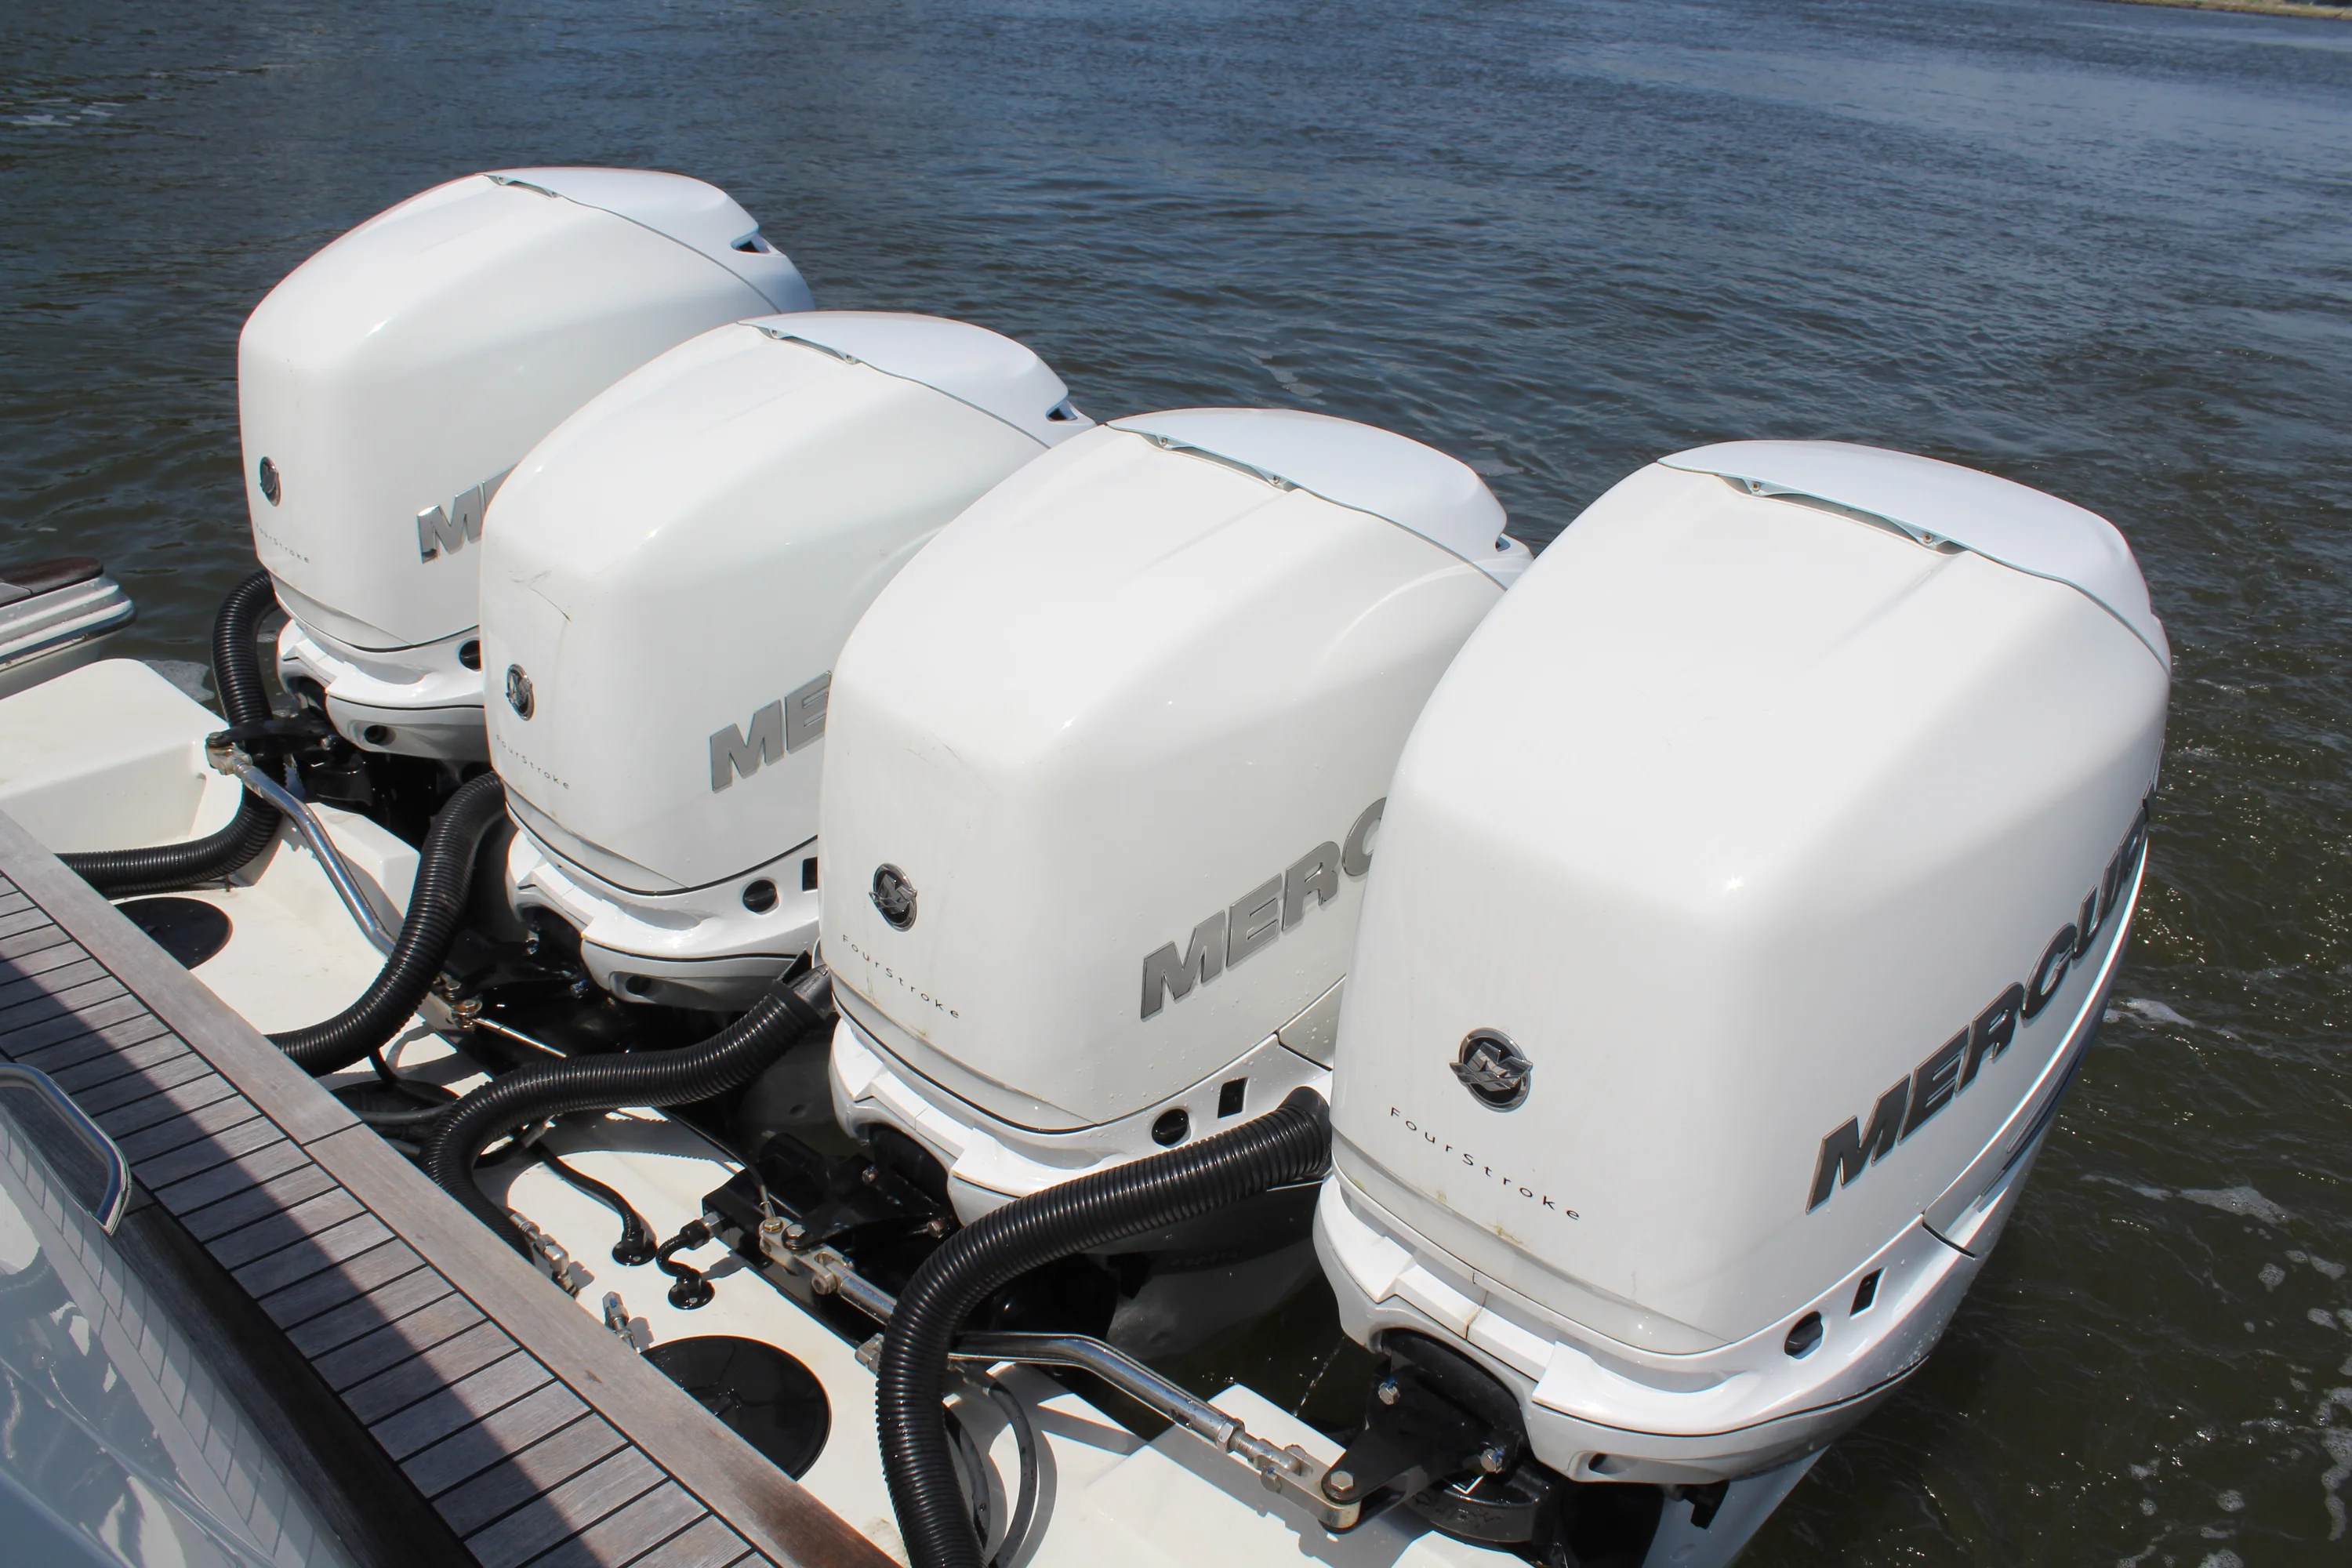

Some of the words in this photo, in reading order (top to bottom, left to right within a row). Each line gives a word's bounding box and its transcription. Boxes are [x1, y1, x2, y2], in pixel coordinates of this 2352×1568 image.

[496, 734, 569, 789] FourStroke
[843, 934, 959, 1018] FourStroke
[1390, 1106, 1580, 1220] FourStroke
